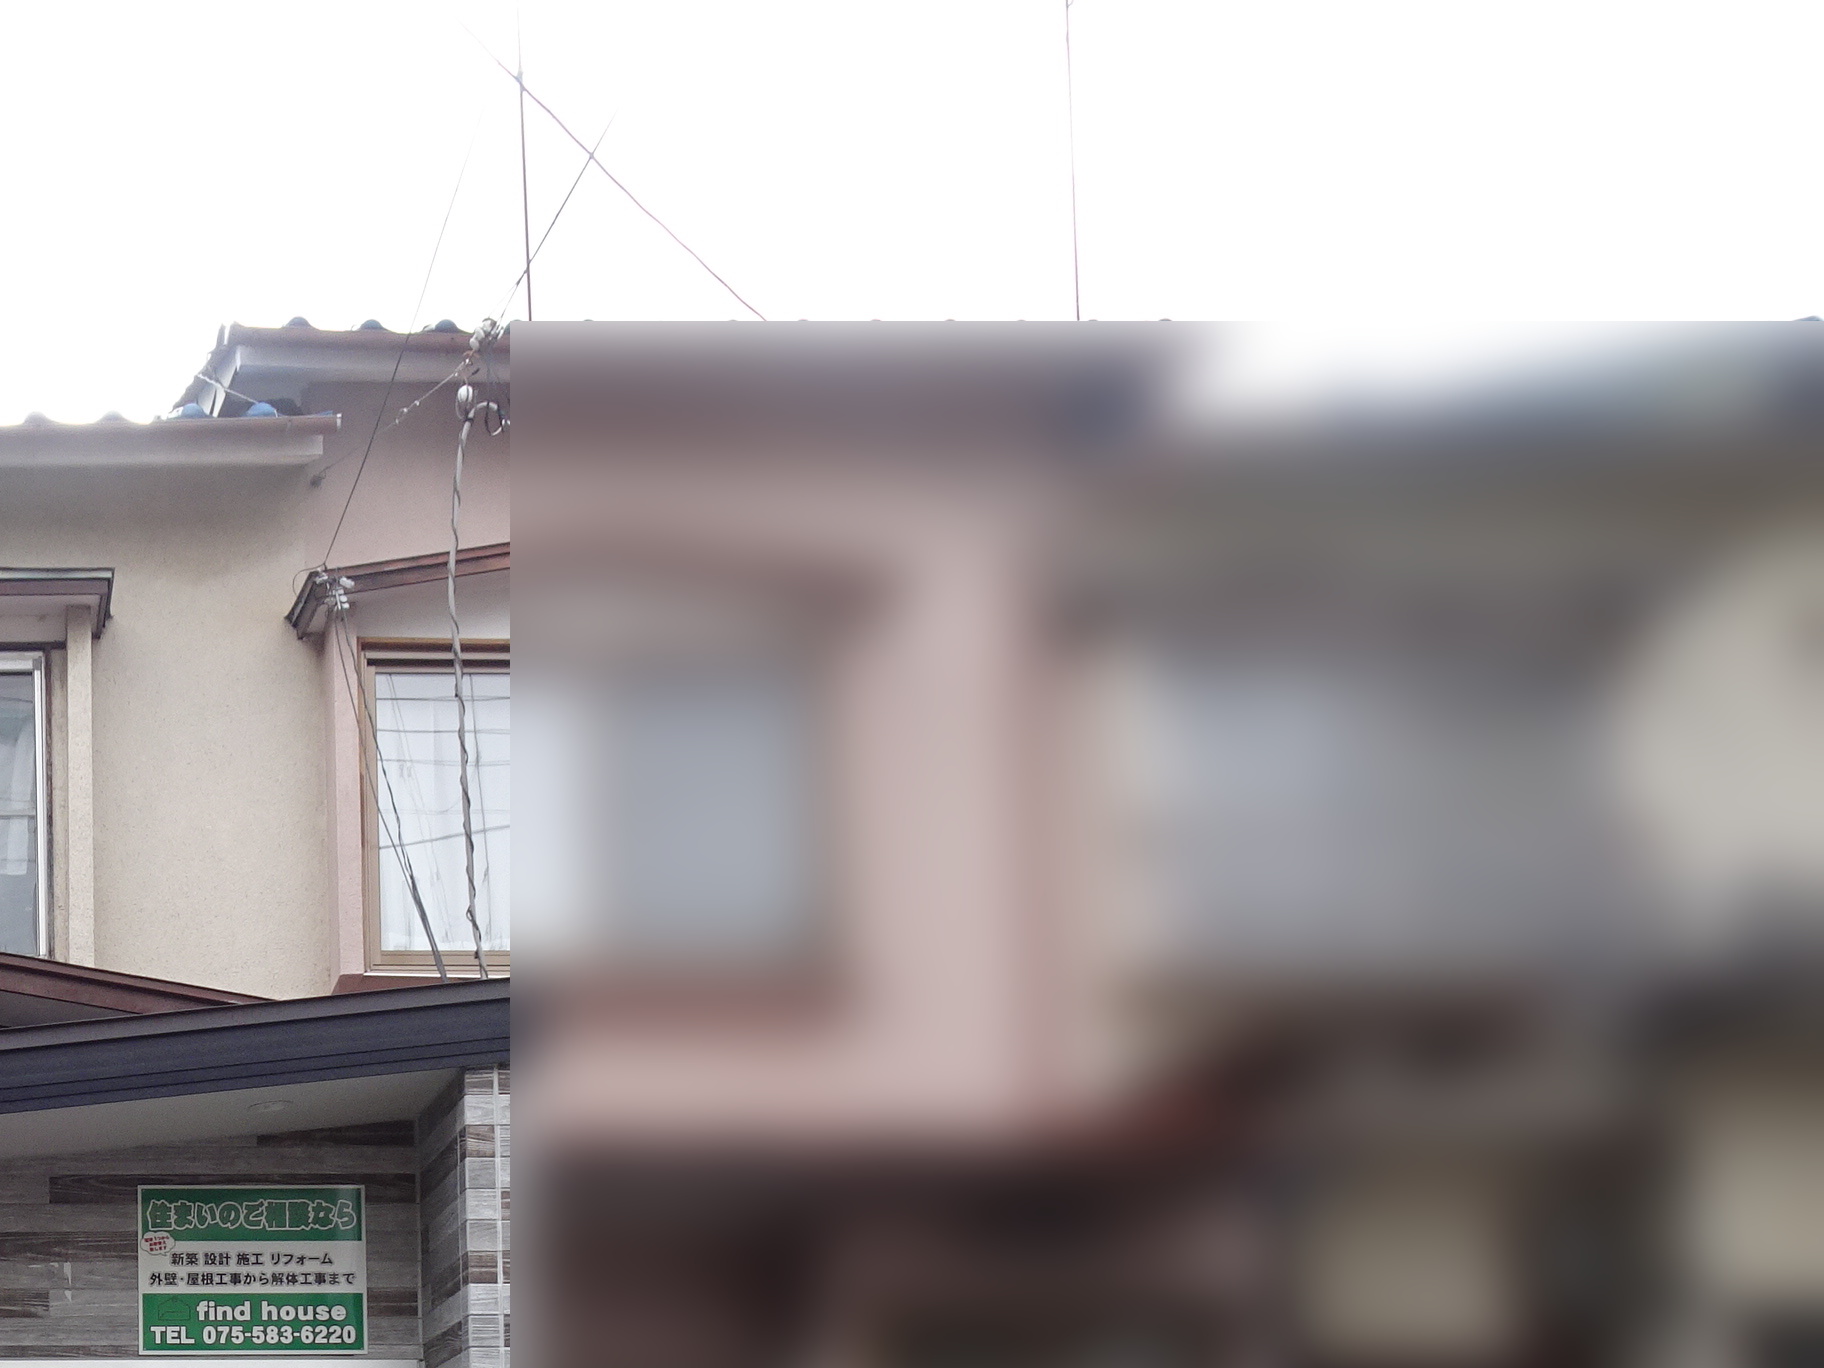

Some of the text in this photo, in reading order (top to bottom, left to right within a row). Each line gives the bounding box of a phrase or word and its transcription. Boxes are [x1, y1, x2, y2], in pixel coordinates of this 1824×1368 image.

[147, 1199, 357, 1231] 住まいのご相談なら
[171, 1252, 333, 1266] 新築 設計 施工 リフォーム
[149, 1272, 356, 1287] 外壁・屋根工事から解体工事まで
[196, 1300, 347, 1321] find house
[150, 1326, 356, 1344] TEL 075-583-6220
